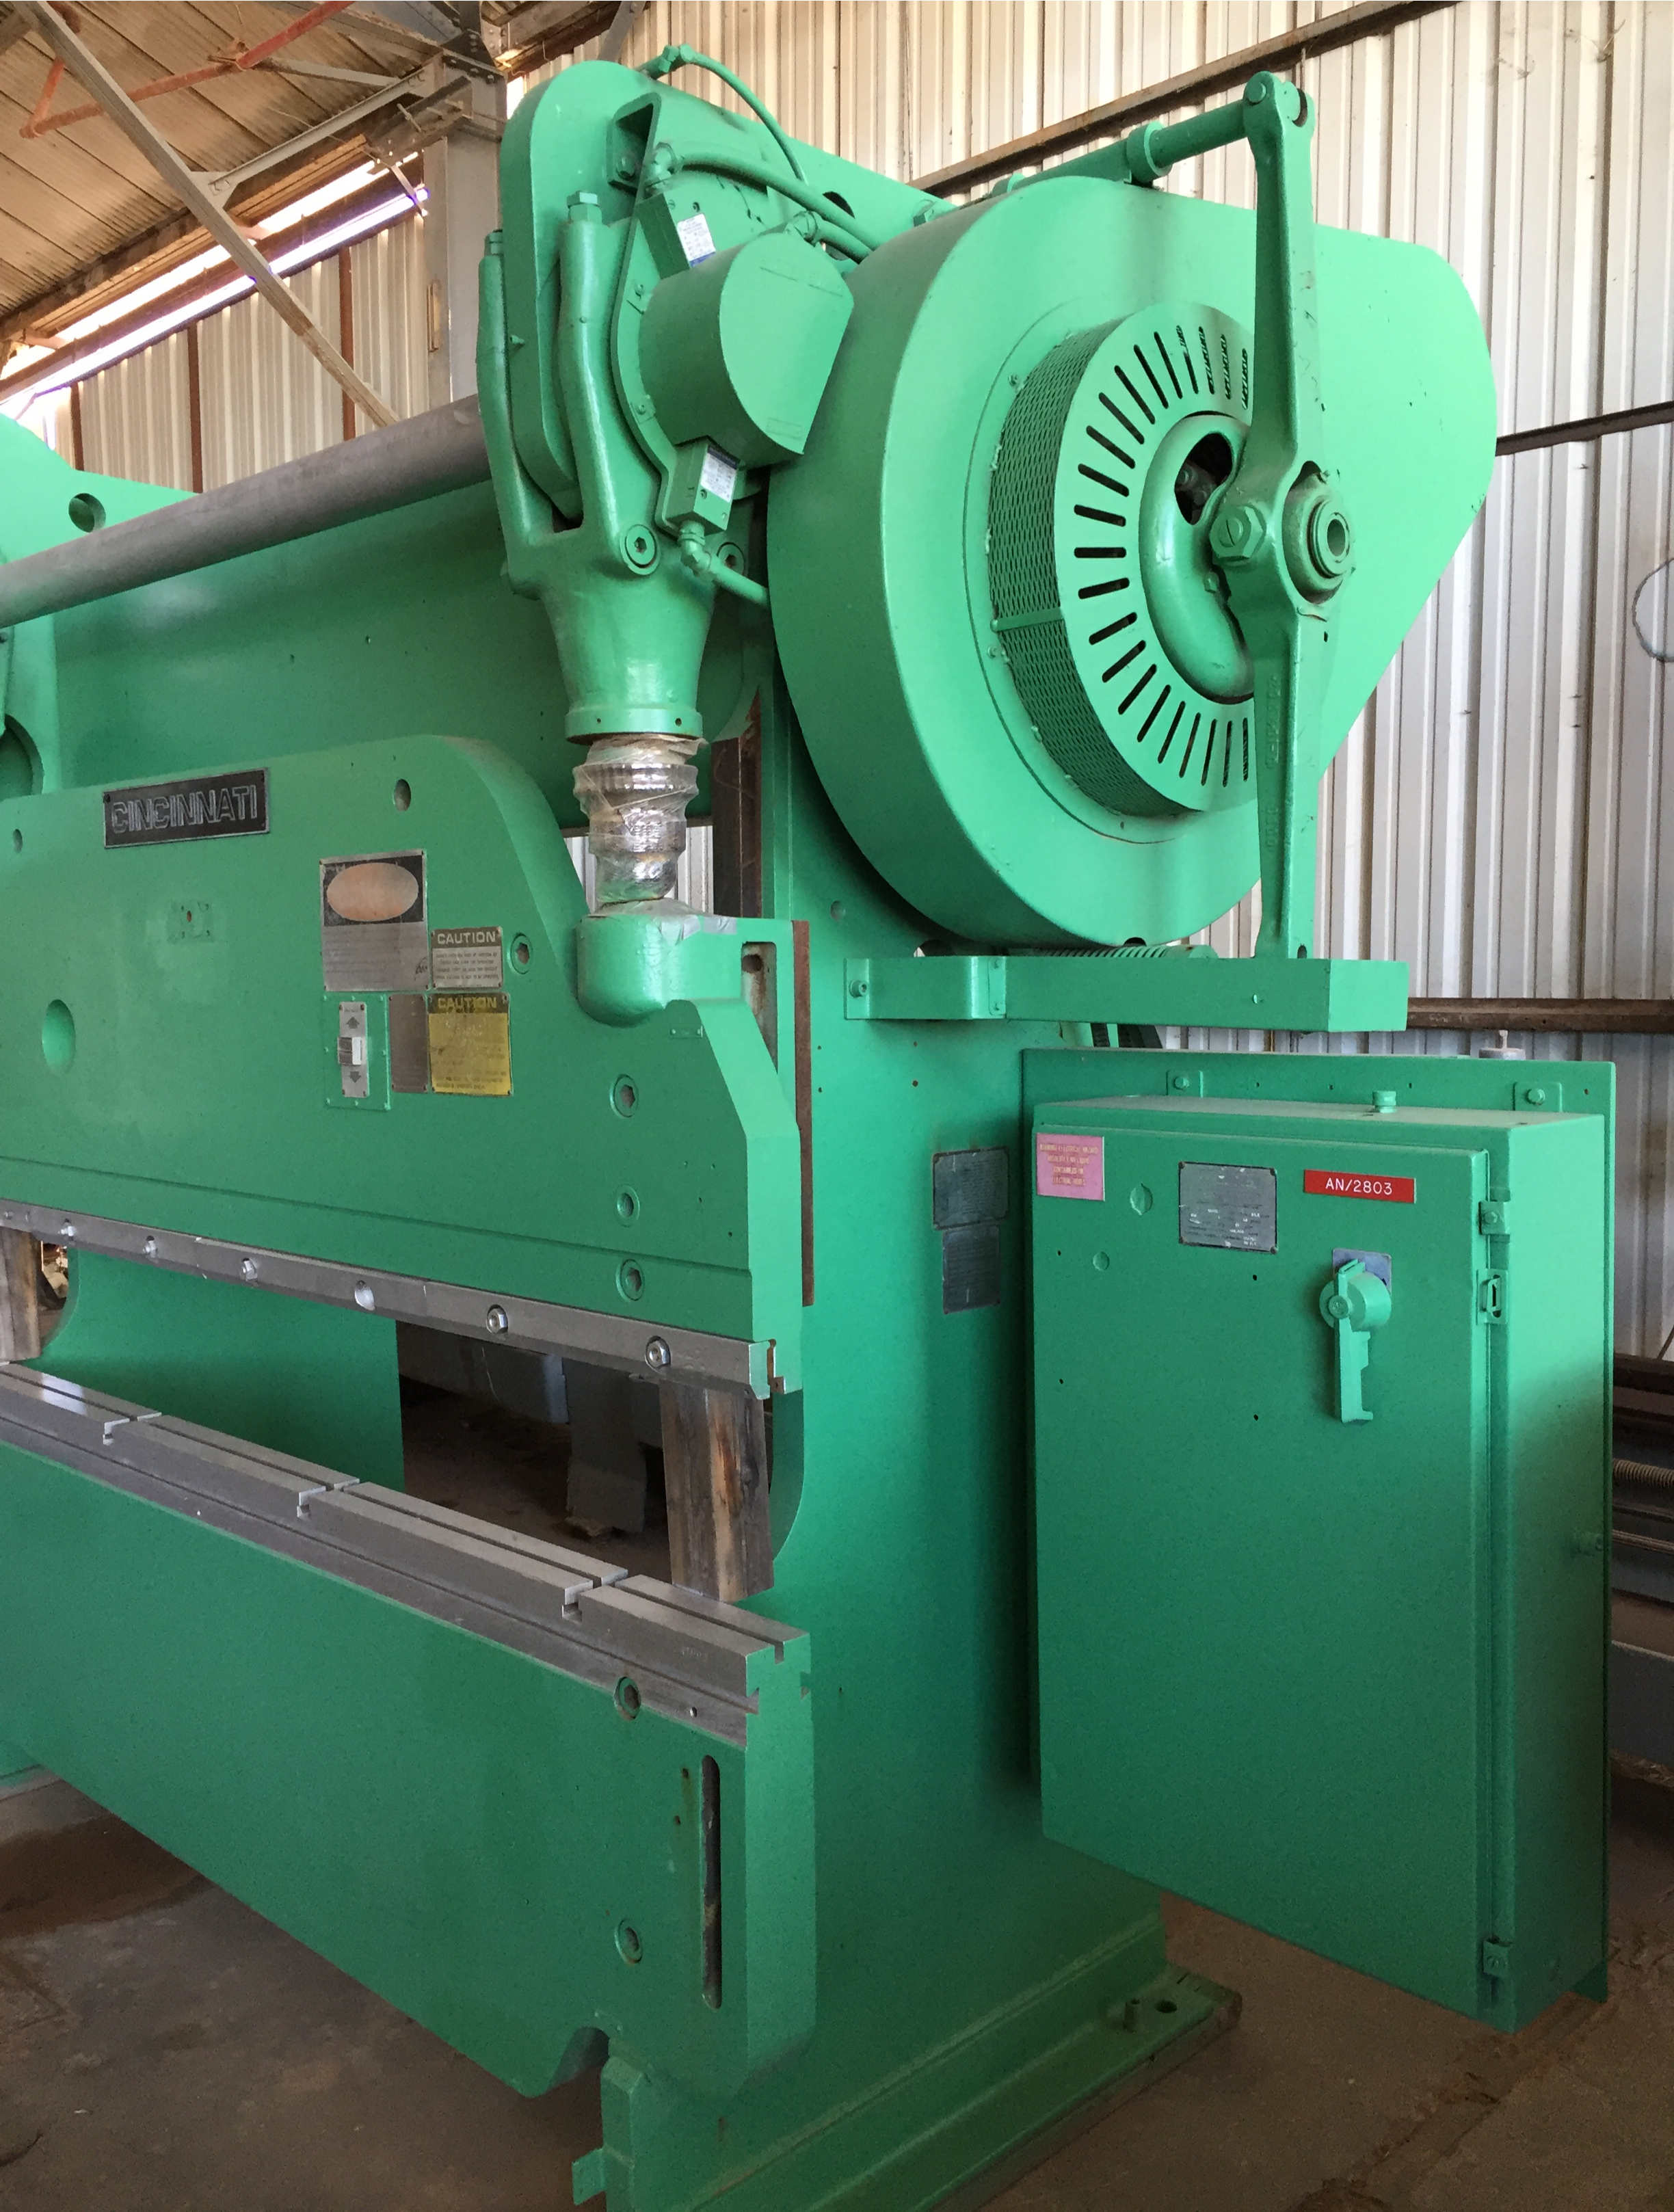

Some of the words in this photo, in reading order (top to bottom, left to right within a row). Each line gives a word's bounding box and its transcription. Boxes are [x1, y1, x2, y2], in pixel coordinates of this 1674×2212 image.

[111, 784, 258, 834] CINCINNATI
[438, 931, 496, 944] CAUTION
[438, 996, 497, 1009] CAUTION
[1325, 1177, 1392, 1195] AN/2803
